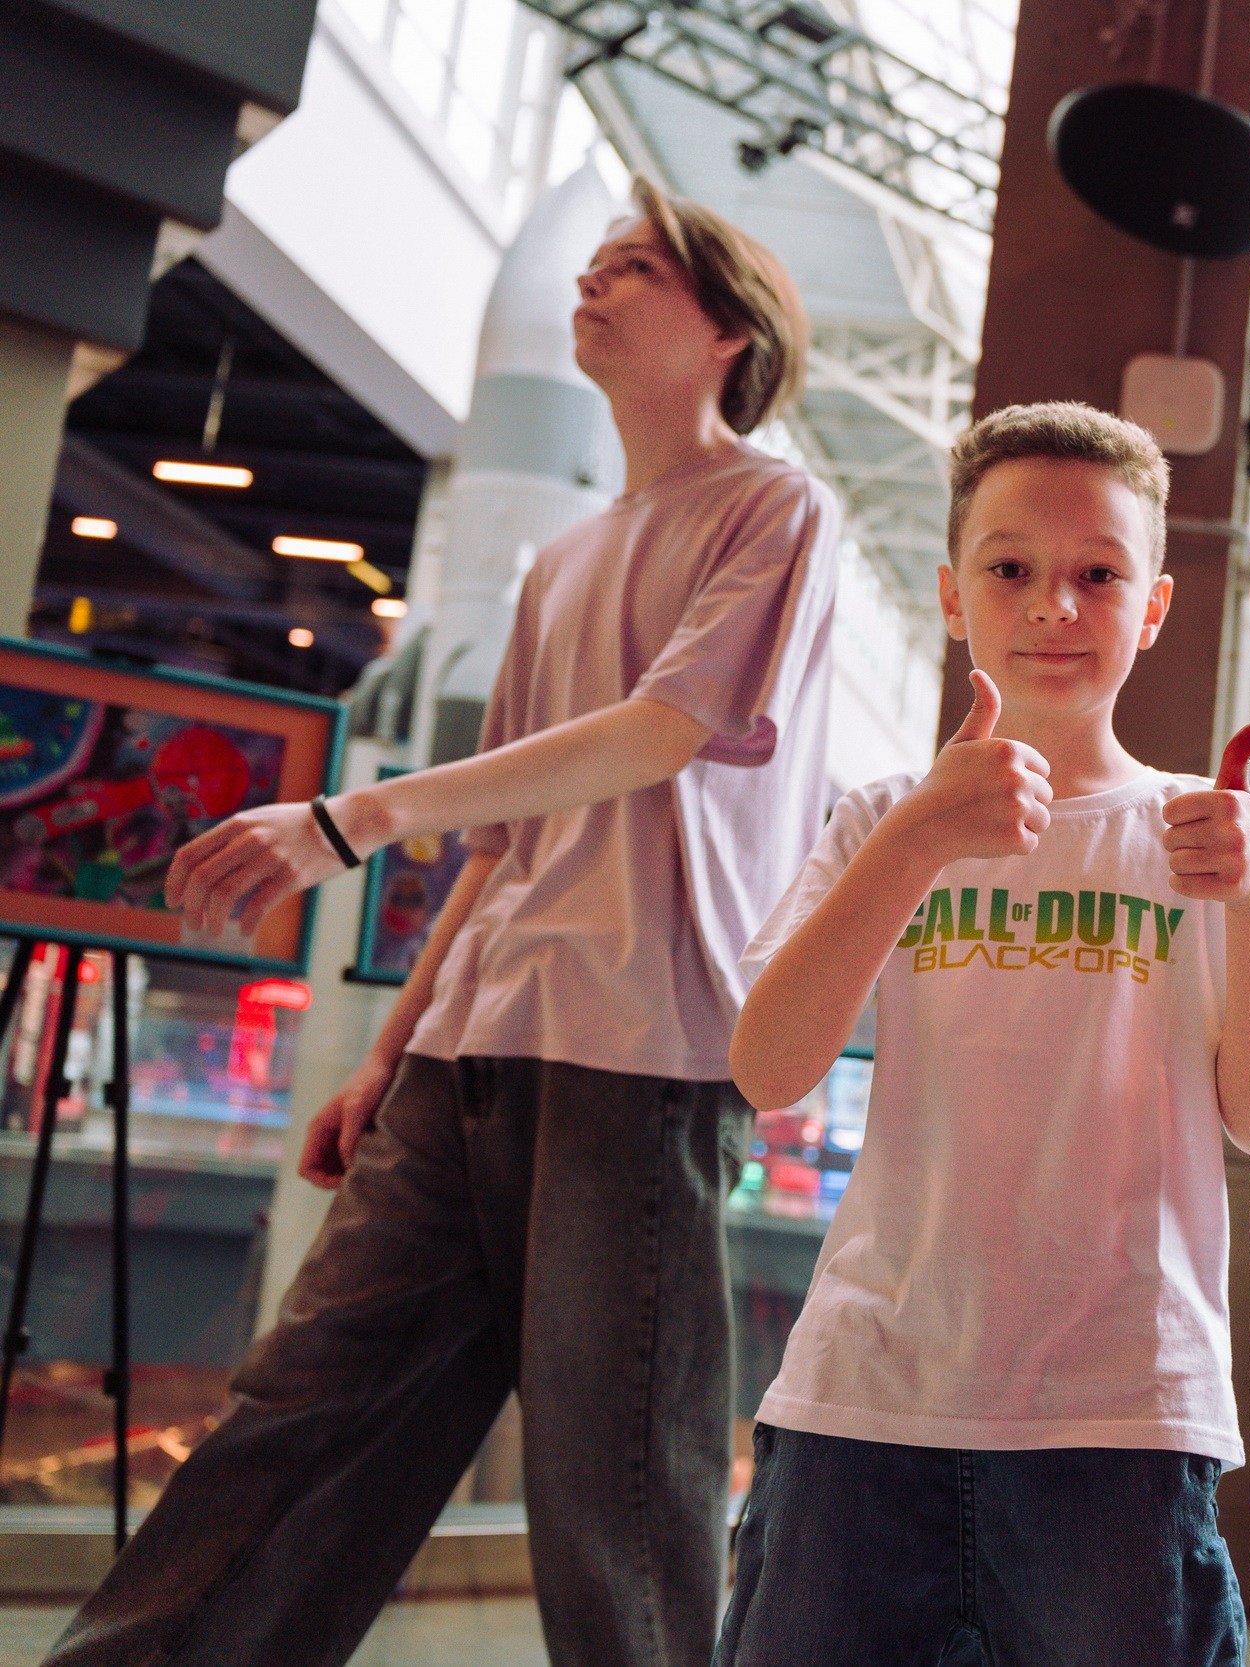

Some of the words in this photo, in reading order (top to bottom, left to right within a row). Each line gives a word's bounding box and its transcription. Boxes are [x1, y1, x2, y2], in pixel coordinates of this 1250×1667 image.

[1011, 902, 1032, 922] OF
[1035, 890, 1185, 963] DUTY
[912, 943, 1068, 974] BLACK
[1074, 946, 1150, 985] OPS
